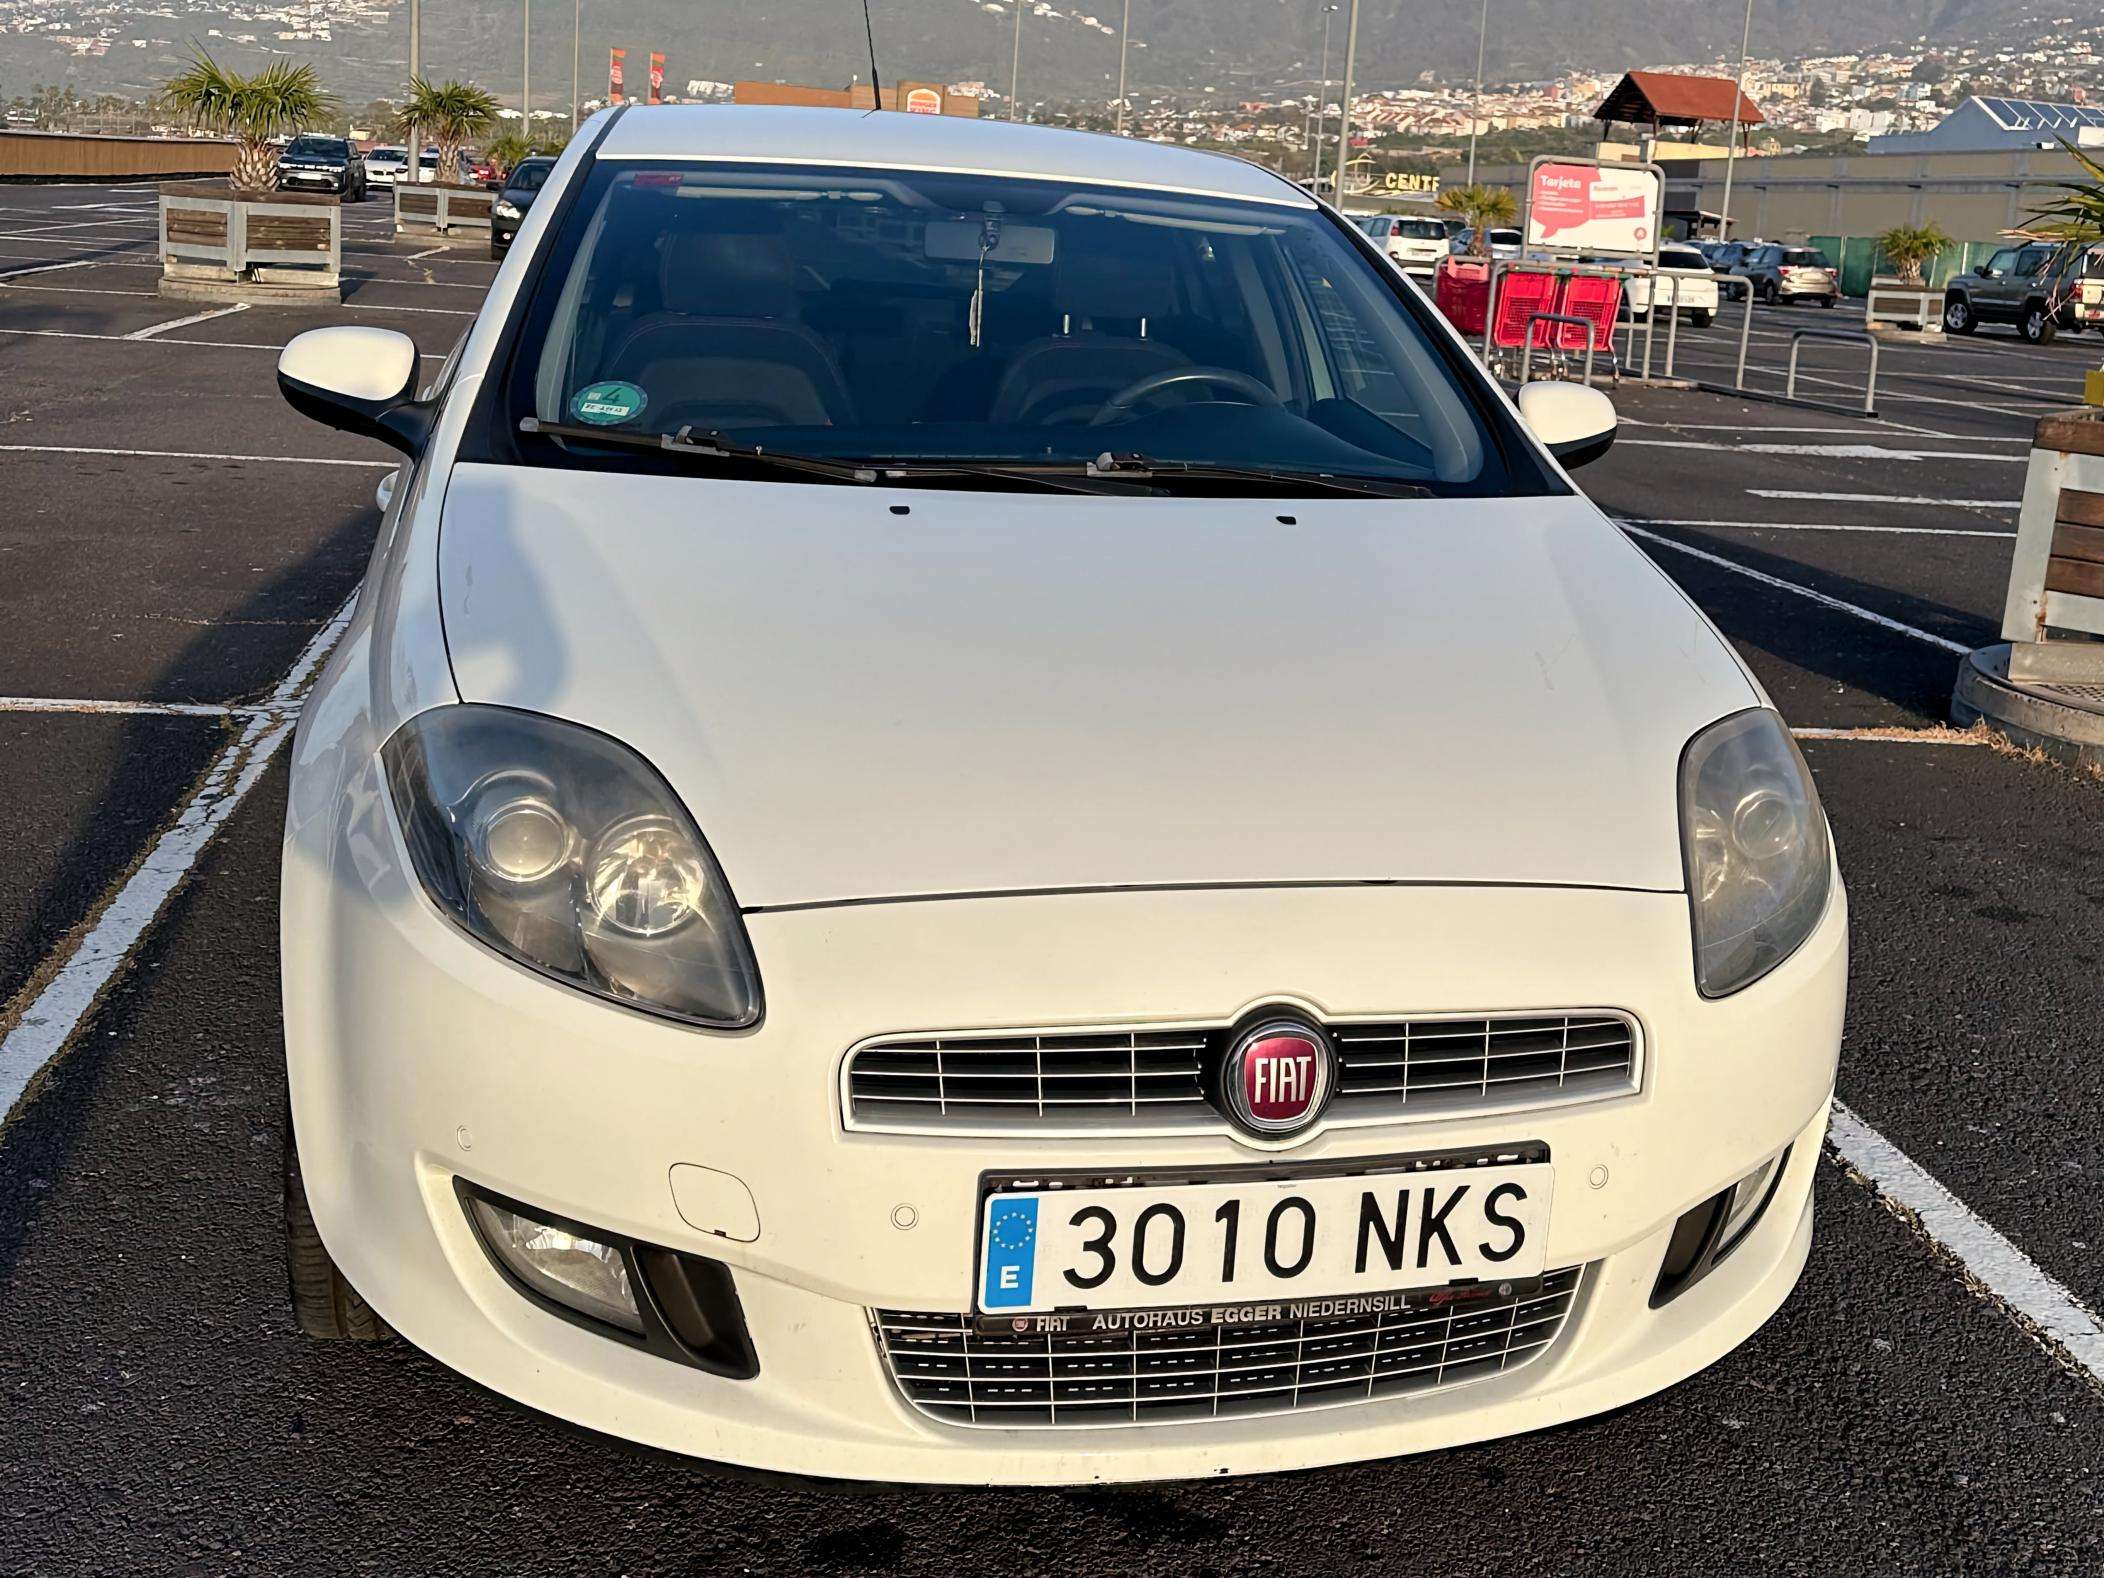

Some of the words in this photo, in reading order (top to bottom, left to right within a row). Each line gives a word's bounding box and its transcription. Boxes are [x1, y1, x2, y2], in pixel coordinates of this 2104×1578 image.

[1254, 1056, 1312, 1103] FIAT
[1062, 1196, 1316, 1290] 3010
[1354, 1182, 1528, 1274] NKS
[1000, 1265, 1020, 1289] E
[1036, 1315, 1070, 1332] FIAT
[1092, 1310, 1204, 1331] AUTOHAUS
[1211, 1304, 1282, 1324] EGGER
[1289, 1294, 1411, 1319] NIEDERNSILL
